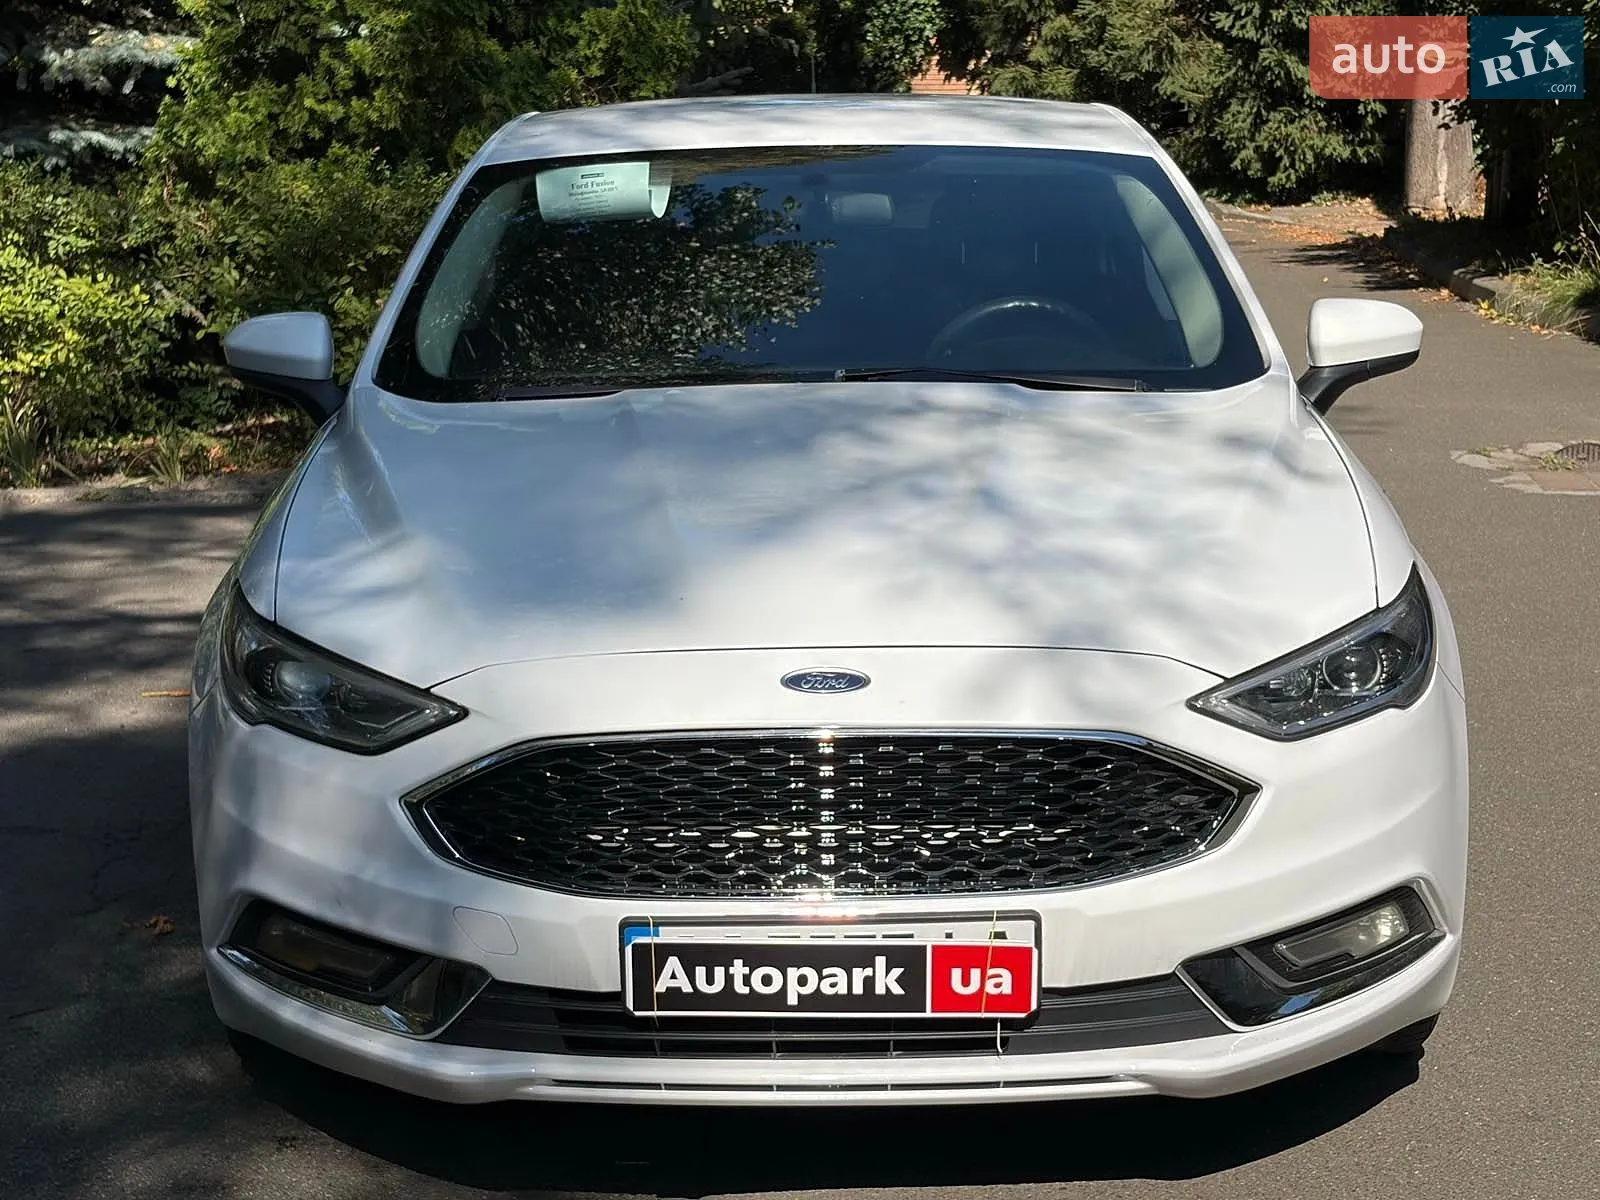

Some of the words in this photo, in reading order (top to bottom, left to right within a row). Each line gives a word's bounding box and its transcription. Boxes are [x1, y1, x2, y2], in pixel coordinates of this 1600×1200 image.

[571, 181, 589, 191] Ford
[591, 179, 615, 188] Fusion
[801, 673, 850, 689] Ford
[654, 955, 905, 1005] Autopark
[950, 967, 1013, 995] ua
